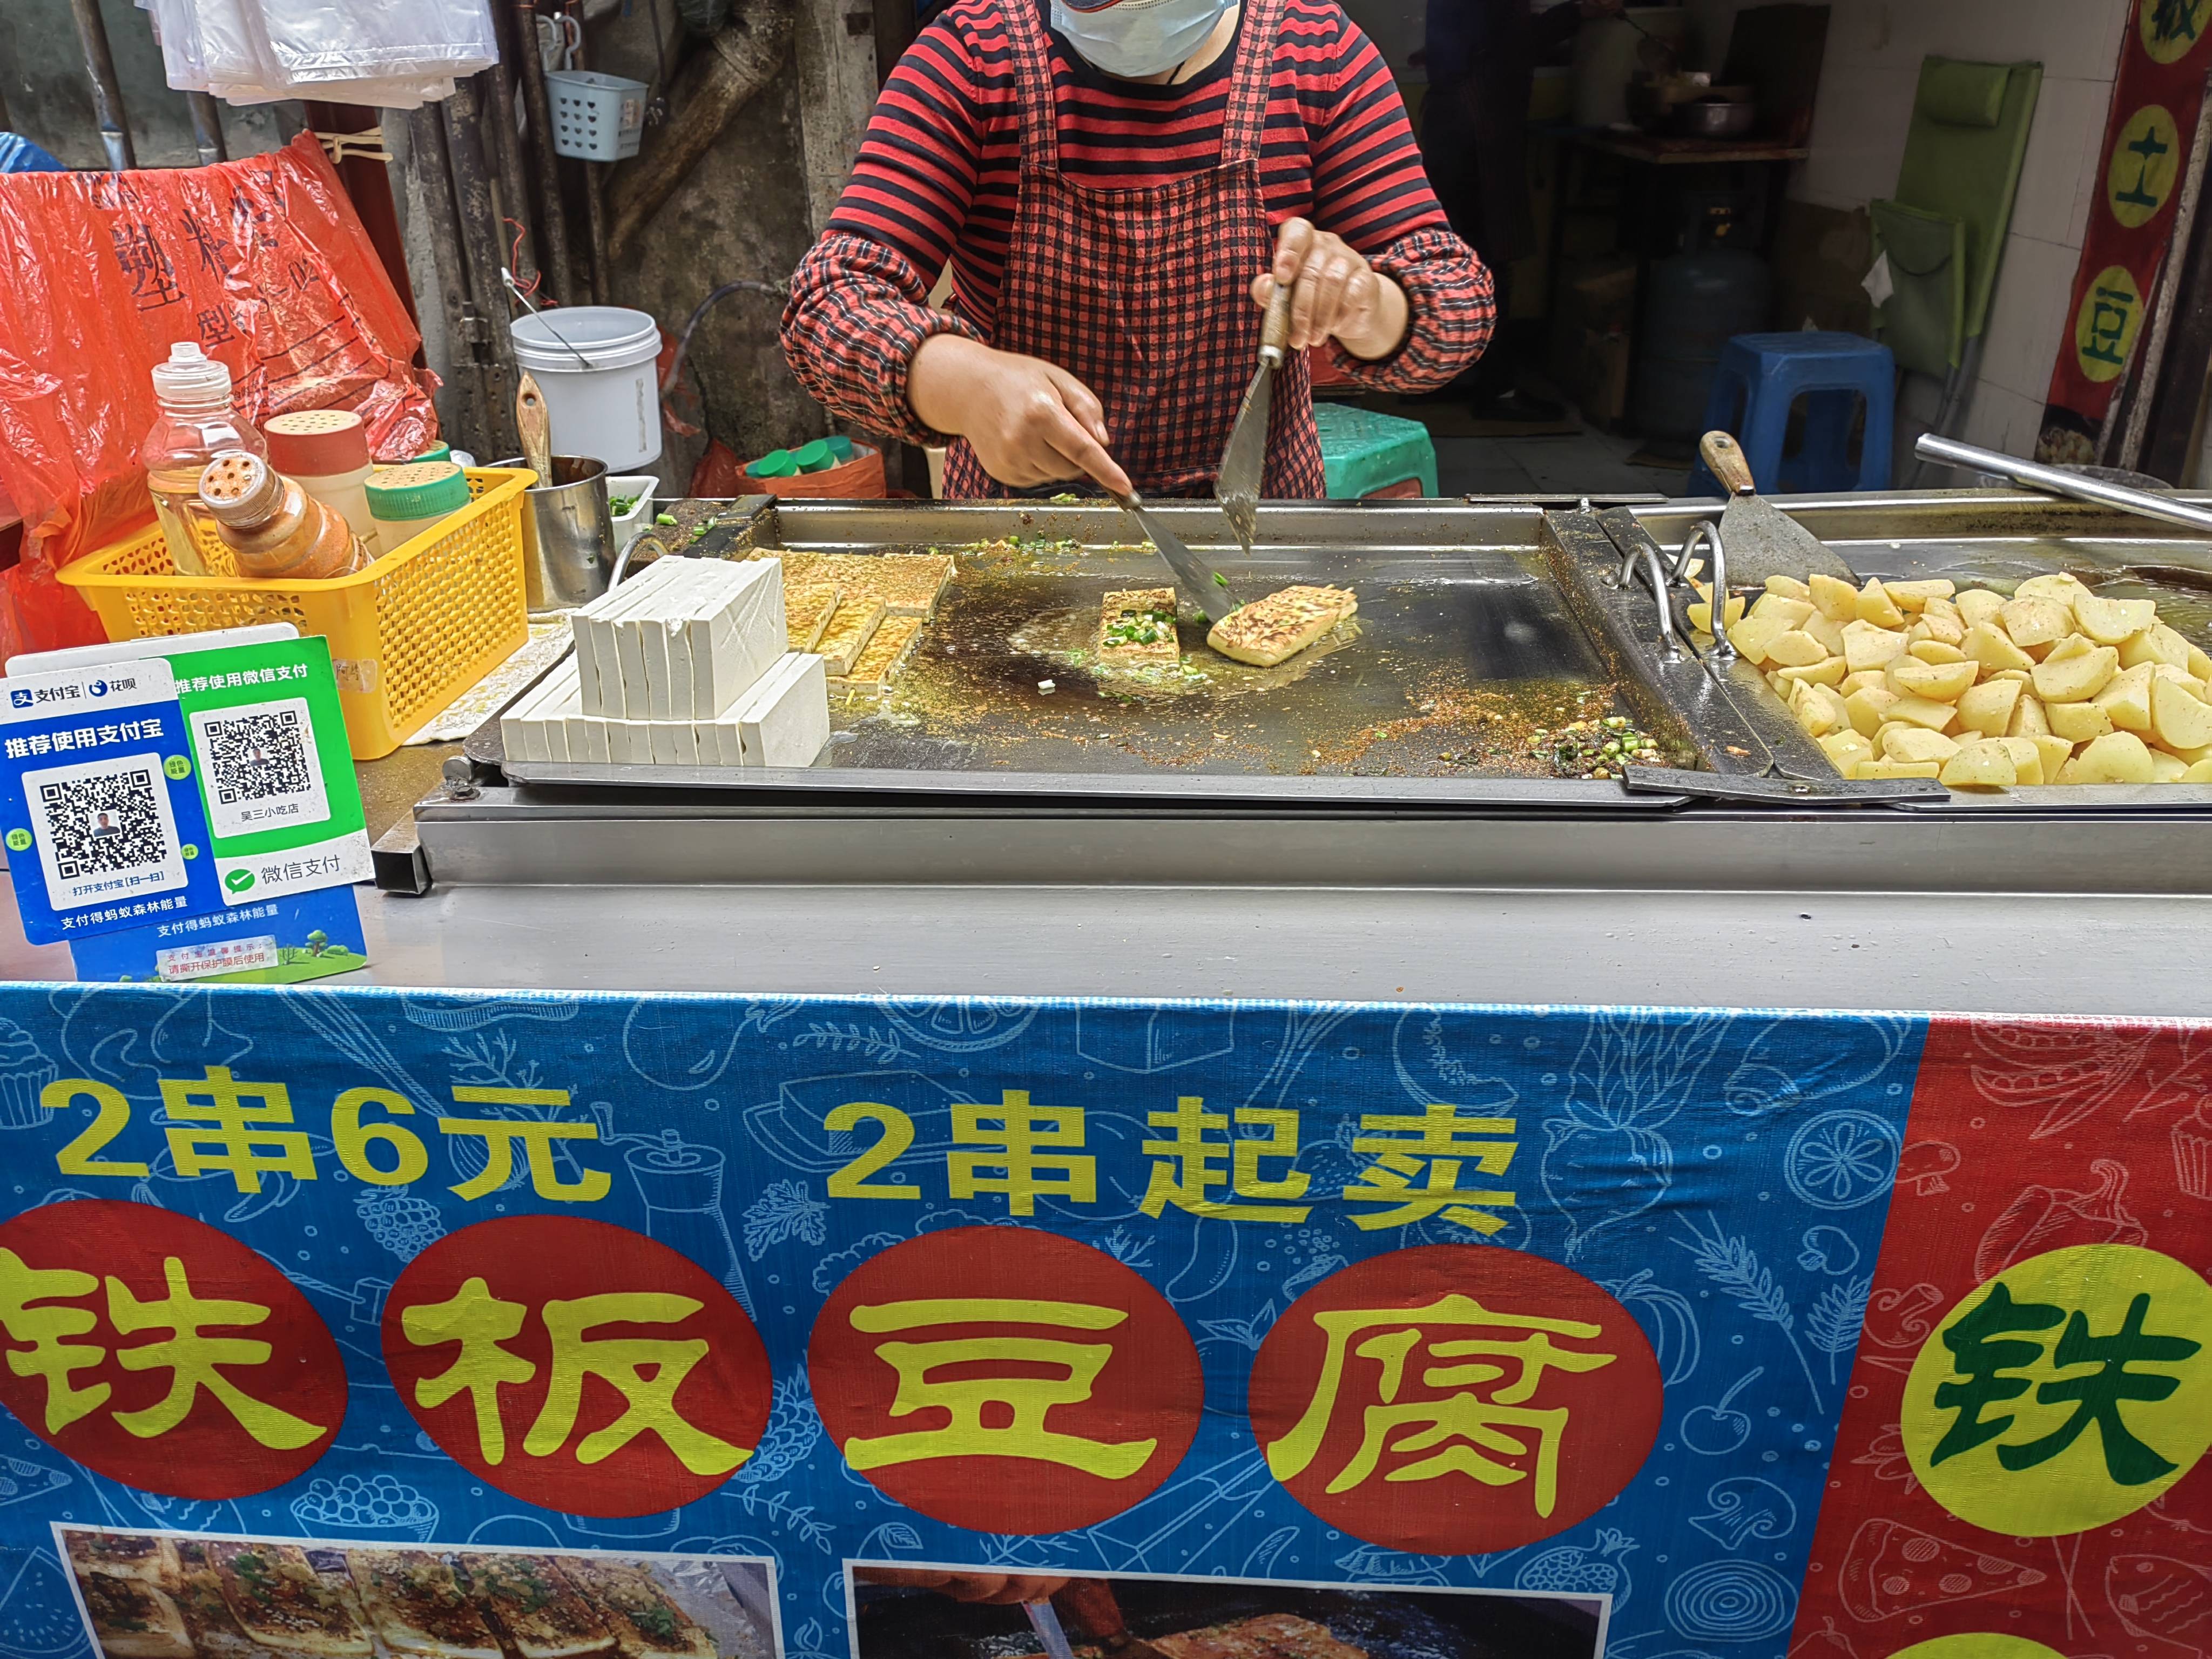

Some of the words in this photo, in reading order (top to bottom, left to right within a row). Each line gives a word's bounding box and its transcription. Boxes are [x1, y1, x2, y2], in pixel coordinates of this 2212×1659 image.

[35, 685, 81, 703] 支付宝
[109, 678, 137, 692] 花呗
[175, 663, 308, 694] 推荐使用微信支付
[5, 719, 164, 759] 推荐使用支付宝
[241, 804, 299, 822] 吴三小吃店
[261, 854, 340, 885] 微信支付
[61, 895, 188, 930] 支付得蚂蚁森林能量
[157, 903, 279, 938] 支付得蚂蚁森林能量
[168, 952, 265, 975] 请撕开保护膜后使用
[39, 1065, 611, 1202] 2串6元
[823, 1089, 1519, 1237] 2串起卖
[0, 1246, 1617, 1519] 铁板豆腐
[1930, 1282, 2202, 1486] 铁
